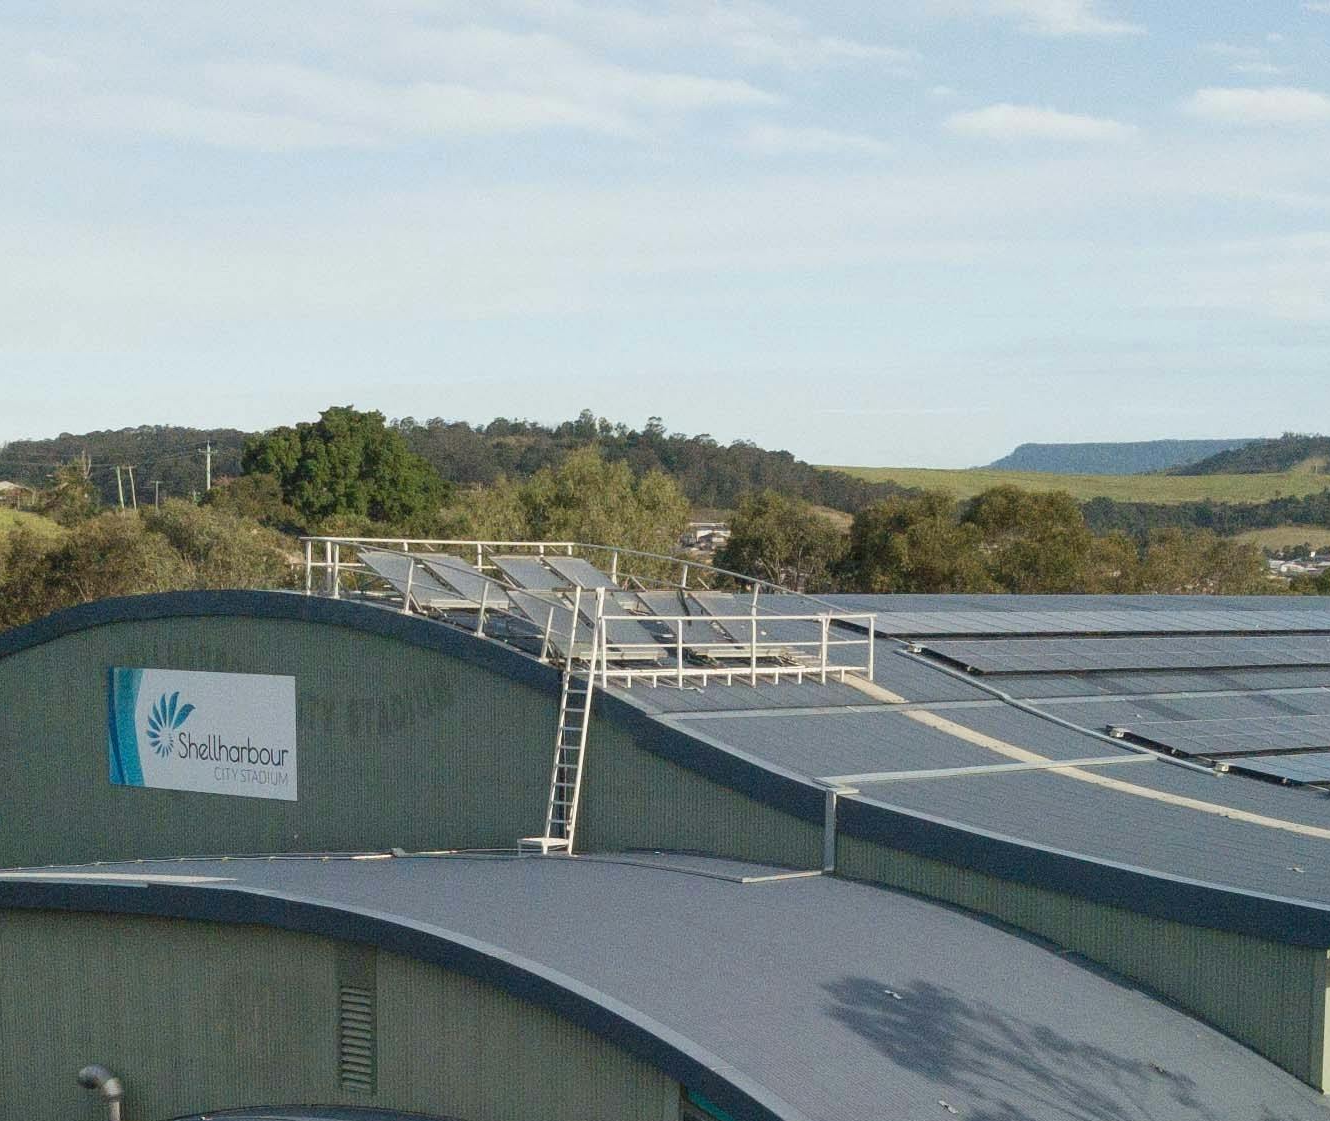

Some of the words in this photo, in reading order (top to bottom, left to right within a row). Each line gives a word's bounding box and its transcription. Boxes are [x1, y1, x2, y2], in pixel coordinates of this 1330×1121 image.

[178, 732, 289, 767] Shellharbour
[214, 766, 238, 781] CITY
[240, 769, 288, 786] STADIUM
